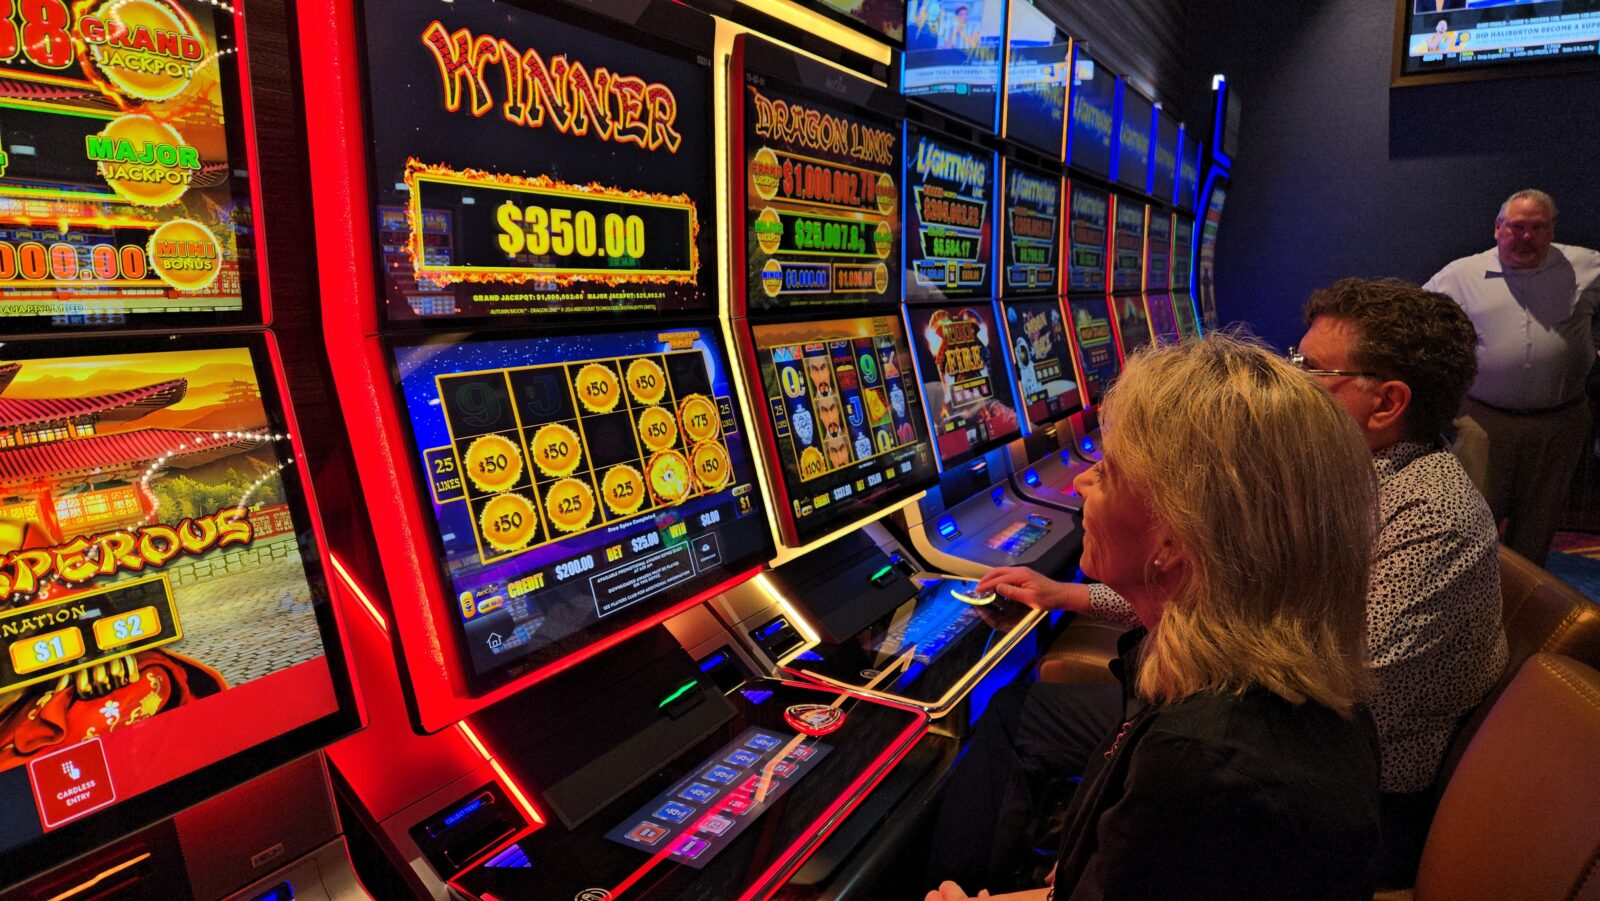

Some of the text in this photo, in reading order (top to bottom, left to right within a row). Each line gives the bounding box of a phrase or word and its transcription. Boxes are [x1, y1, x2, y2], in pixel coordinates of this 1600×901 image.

[79, 15, 204, 61] GRAND
[1491, 28, 1539, 39] HALIBURTON
[1541, 24, 1572, 34] BECOME
[101, 51, 192, 80] JACKPOT
[421, 20, 682, 153] WINNER
[754, 95, 849, 155] DRAGON
[85, 135, 201, 169] MAJOR
[917, 136, 985, 191] LIGHTNING
[106, 166, 191, 185] JACKPOT
[497, 200, 645, 258] $350.00
[157, 240, 216, 260] MINI
[163, 257, 212, 271] BONUS
[473, 294, 499, 302] GRAND
[0, 304, 25, 314] ALIA
[859, 353, 878, 384] 9
[945, 345, 984, 376] FIRE
[585, 380, 610, 397] $50
[635, 373, 657, 390] $50
[782, 366, 806, 399] Q
[720, 403, 731, 416] 25
[774, 404, 784, 417] 25
[846, 395, 864, 427] J
[647, 421, 668, 438] $50
[690, 413, 709, 429] $75
[543, 443, 569, 461] $50
[434, 458, 455, 473] 25
[479, 452, 508, 473] $50
[701, 457, 720, 474] $50
[435, 475, 461, 494] LINES
[612, 480, 634, 499] $25
[557, 495, 582, 515] $25
[493, 512, 523, 533] $50
[631, 512, 656, 526] Completed
[0, 506, 251, 598] PEROUS
[507, 572, 545, 599] CREDIT
[555, 554, 595, 582] $200.00
[606, 543, 624, 562] BET
[631, 531, 660, 553] $25.00
[668, 521, 688, 539] WIN
[700, 510, 720, 528] $0.00
[113, 614, 144, 640] $2
[34, 636, 65, 663] $1
[56, 779, 96, 802] CARDLESS
[65, 791, 91, 807] ENTRY
